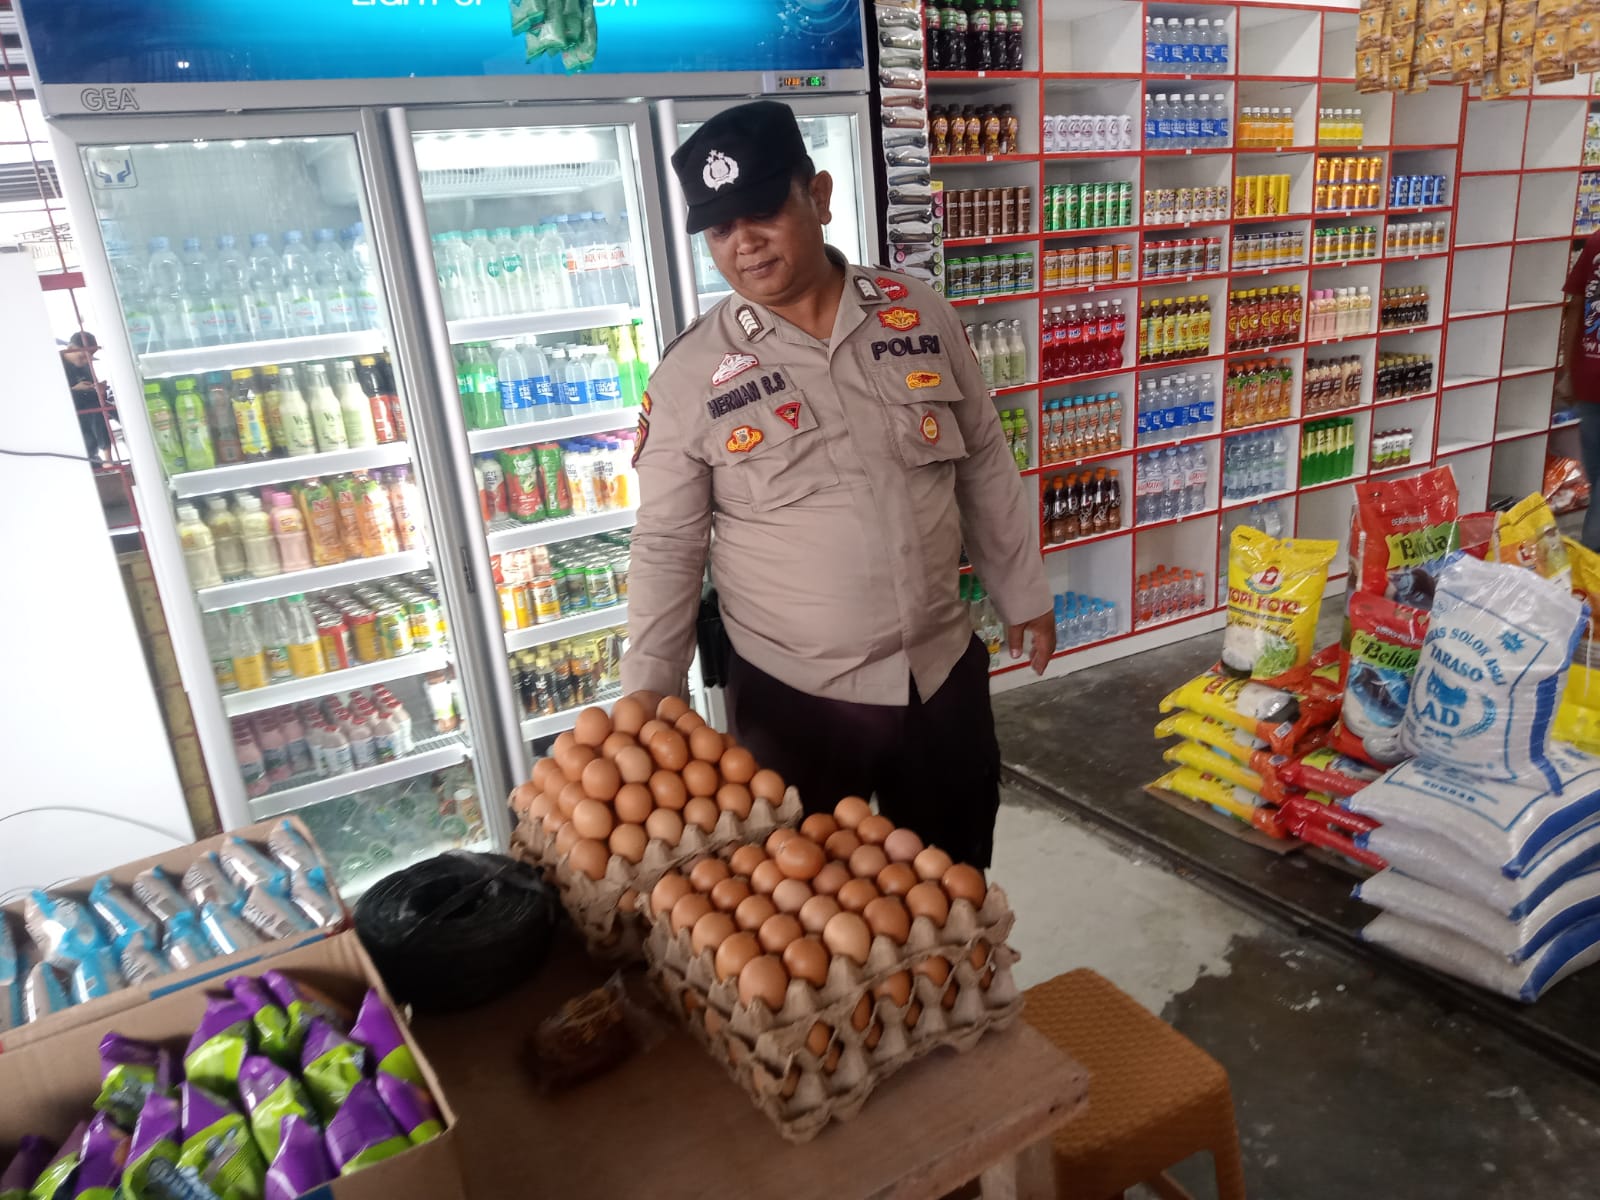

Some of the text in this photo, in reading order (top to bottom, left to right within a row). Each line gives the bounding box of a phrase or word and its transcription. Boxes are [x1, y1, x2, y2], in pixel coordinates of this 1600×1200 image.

[81, 88, 140, 111] GEA
[871, 334, 940, 361] POLRI
[706, 372, 786, 420] HERMAN R.S
[1449, 627, 1491, 658] SOLOK
[1430, 642, 1484, 682] TARASO
[1420, 700, 1460, 728] AD
